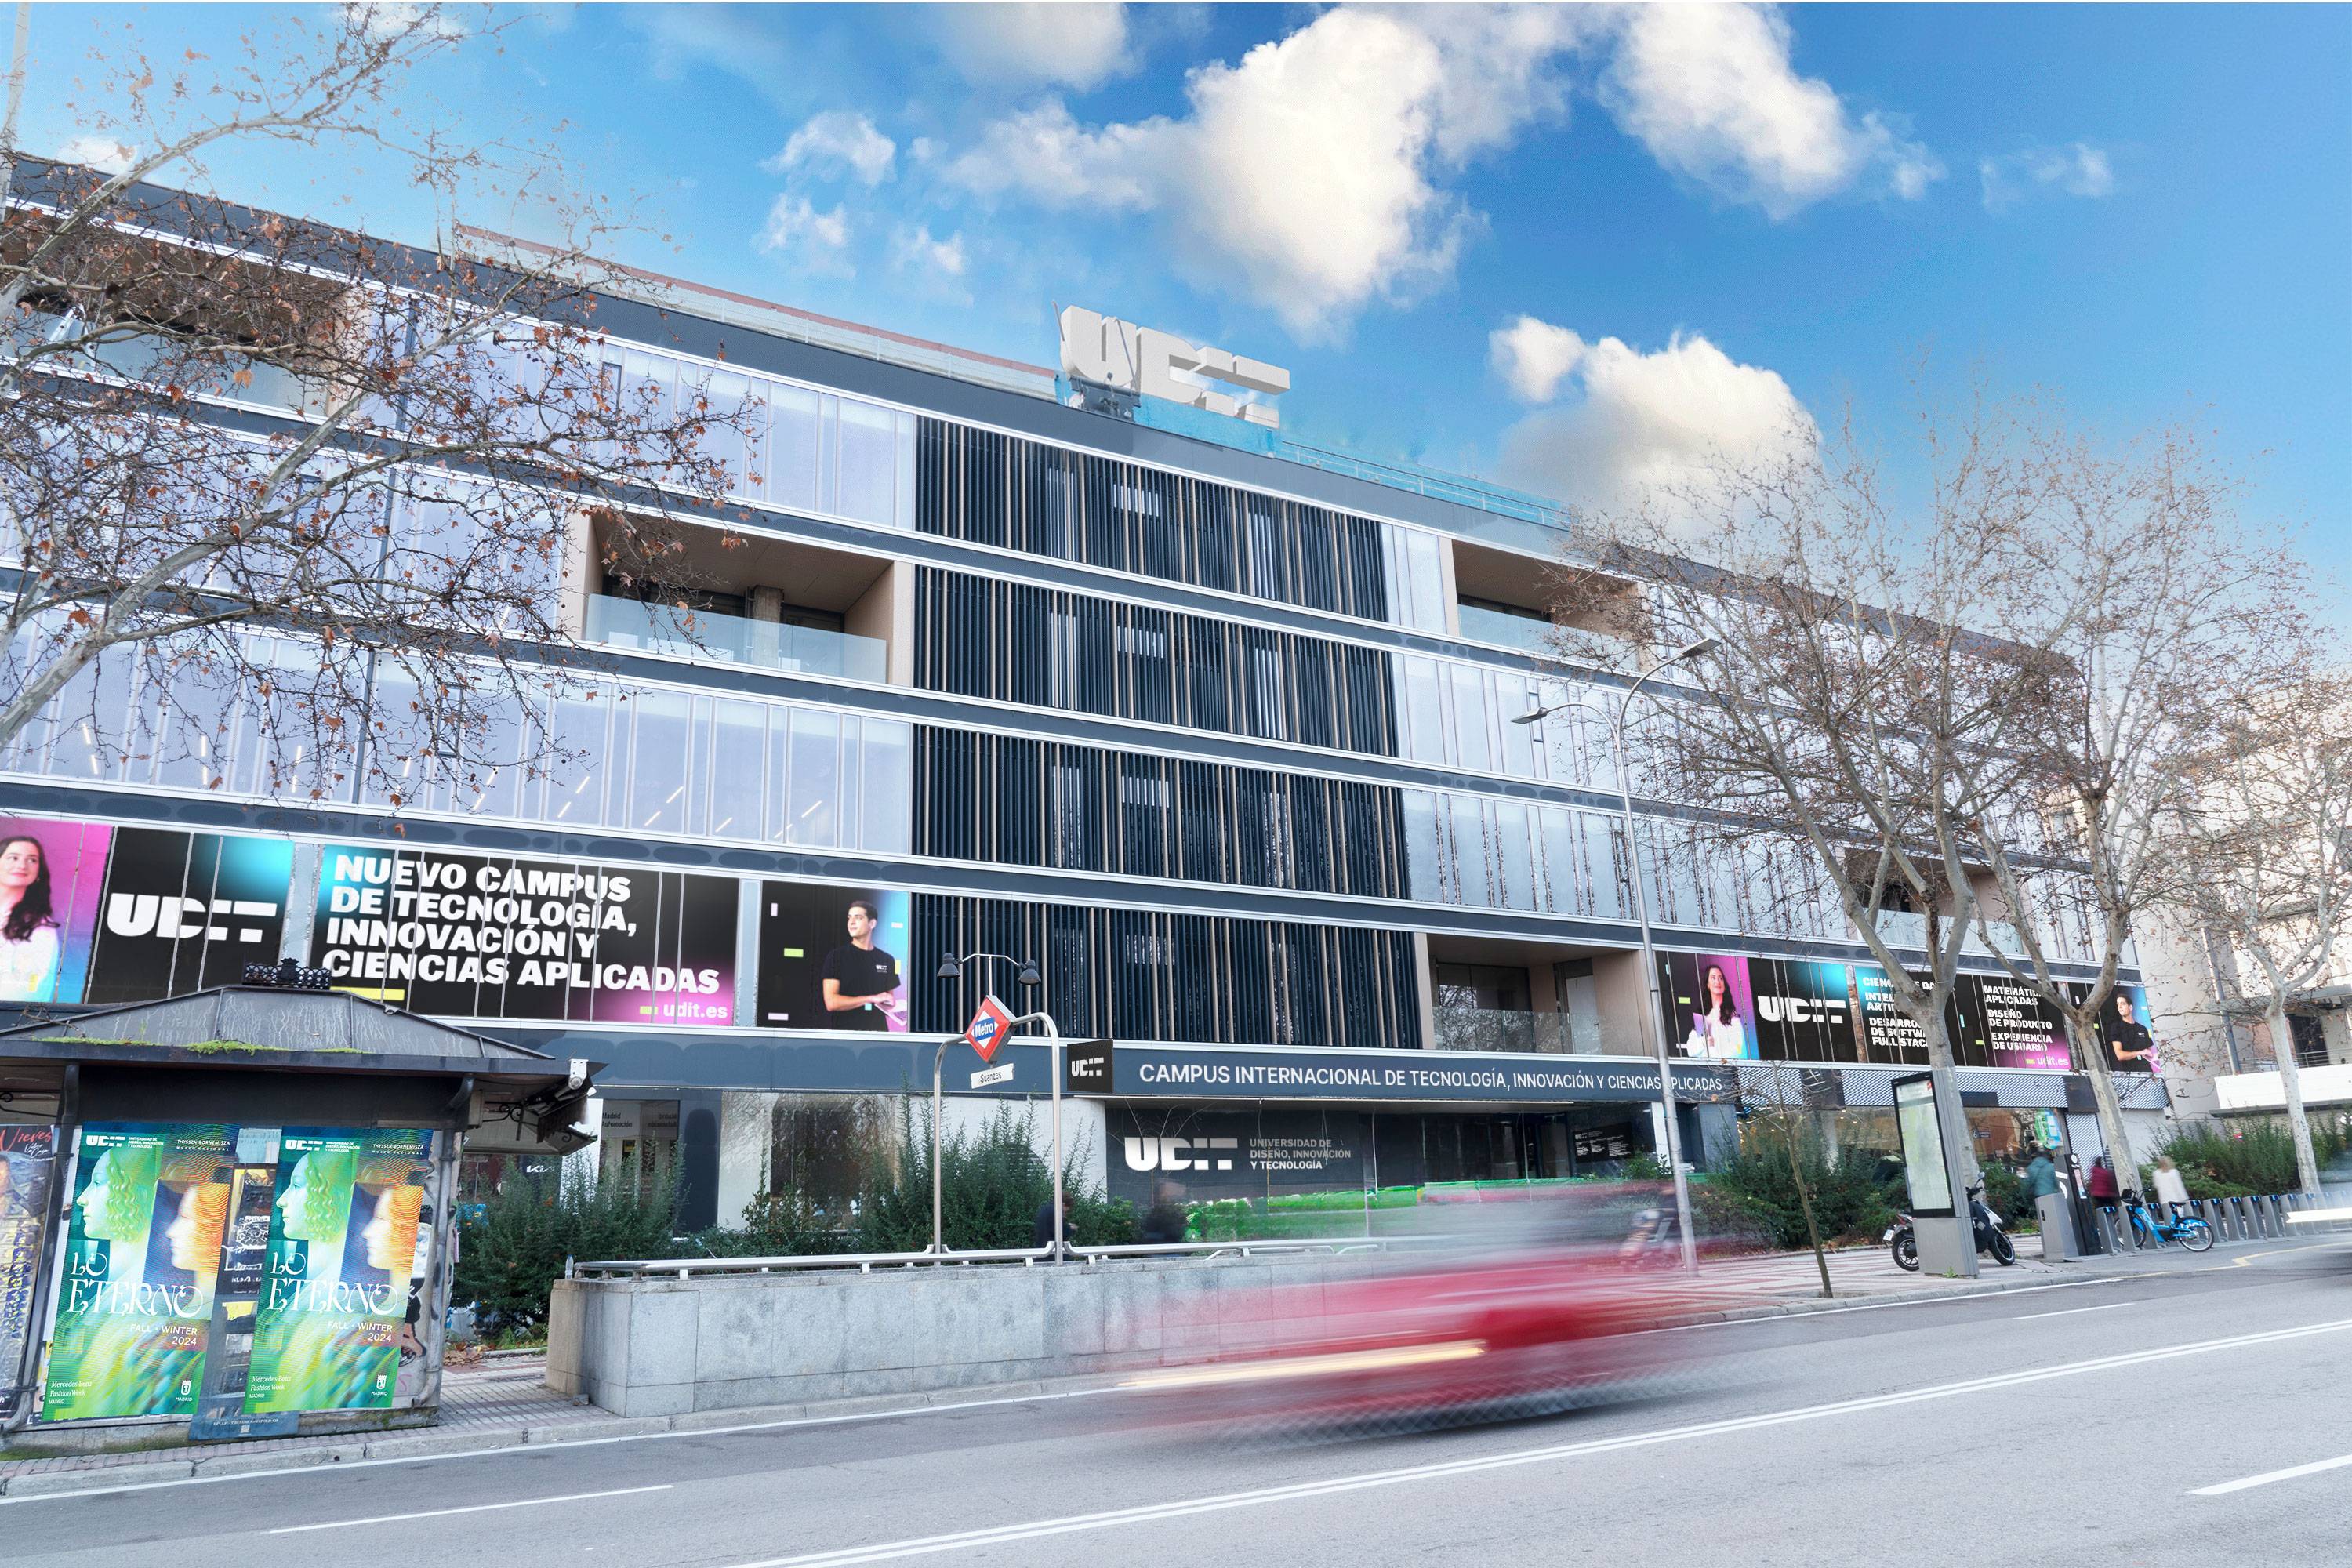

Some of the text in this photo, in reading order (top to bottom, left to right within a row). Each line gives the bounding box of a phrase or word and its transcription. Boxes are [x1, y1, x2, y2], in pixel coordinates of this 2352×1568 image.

[334, 855, 631, 902] NUEVO CAMPUS
[330, 887, 637, 937] DE TECNOLOGÍA,
[326, 918, 601, 958] INNOVACIÓN Y
[322, 949, 720, 994] CIENCIAS APLICADAS
[1986, 995, 2038, 1005] APLICADAS
[662, 1003, 728, 1018] udit.es
[1987, 1009, 2022, 1019] DISEÑO
[1989, 1018, 2053, 1029] DE PRODUCTO
[975, 1022, 993, 1037] Metro
[1871, 1027, 1885, 1036] DE
[1872, 1037, 1898, 1046] FULL
[1991, 1032, 2053, 1043] EXPERIENCIA
[1994, 1041, 2047, 1051] DE USUARIO
[980, 1072, 1002, 1083] Suanzes
[1139, 1064, 1722, 1091] CAMPUS INTERNACIONAL DE TECNOLOGÍA, INNOVACIÓN Y CIENCIAS PLICADAS
[1250, 1139, 1317, 1148] UNIVERSIDAD
[1250, 1148, 1351, 1160] DISEÑO, INNOVACIÓN
[1259, 1160, 1323, 1170] TECNOLOGÍA
[71, 1252, 107, 1276] LO
[270, 1251, 306, 1276] LO
[66, 1279, 204, 1318] ETERNO
[267, 1277, 397, 1316] ETERNO
[131, 1324, 198, 1335] FALL WINTER
[328, 1321, 393, 1332] FALL WINTER
[172, 1336, 197, 1346] 2024
[368, 1333, 392, 1342] 2024
